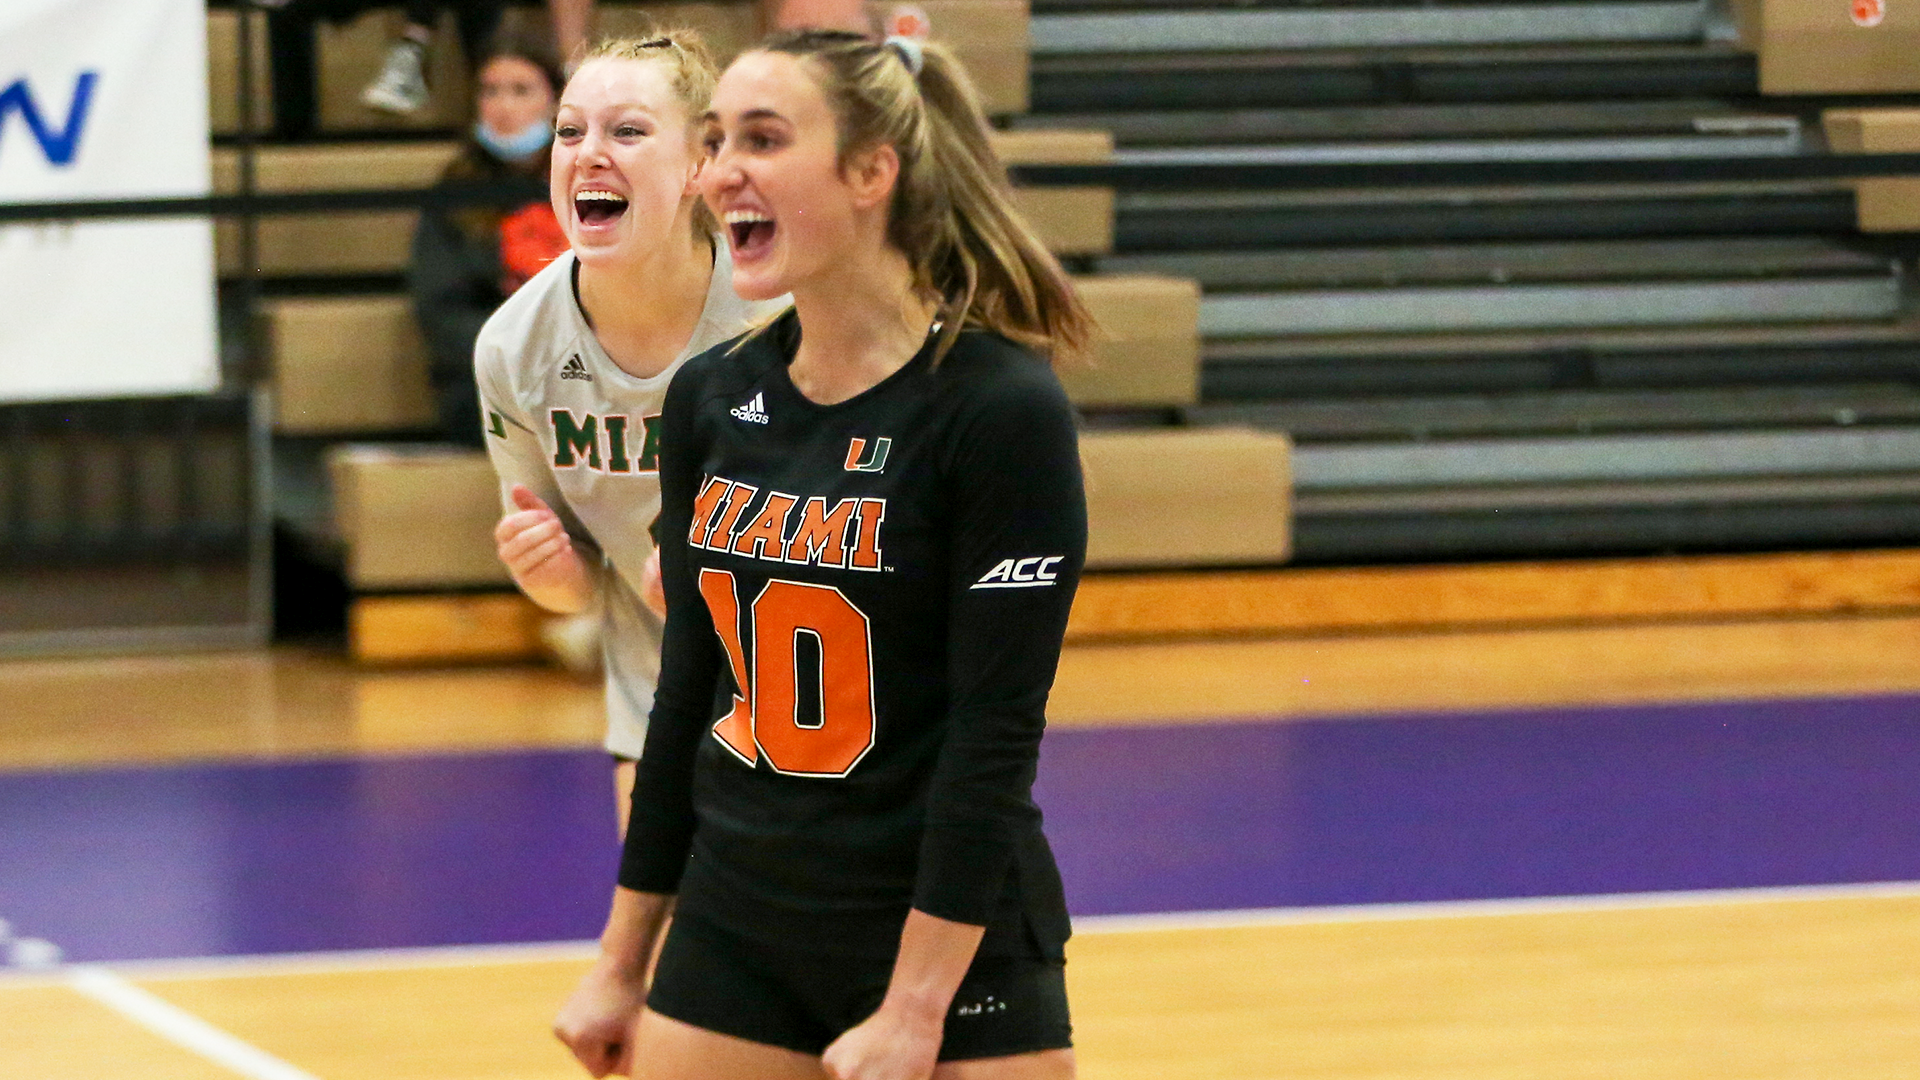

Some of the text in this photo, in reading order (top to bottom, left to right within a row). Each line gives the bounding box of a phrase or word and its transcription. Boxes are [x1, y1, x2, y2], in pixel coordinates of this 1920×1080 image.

[560, 370, 593, 382] adidas
[730, 408, 770, 425] adidas
[688, 474, 887, 572] MIAMI
[977, 555, 1065, 583] ACC
[698, 567, 877, 778] 10
